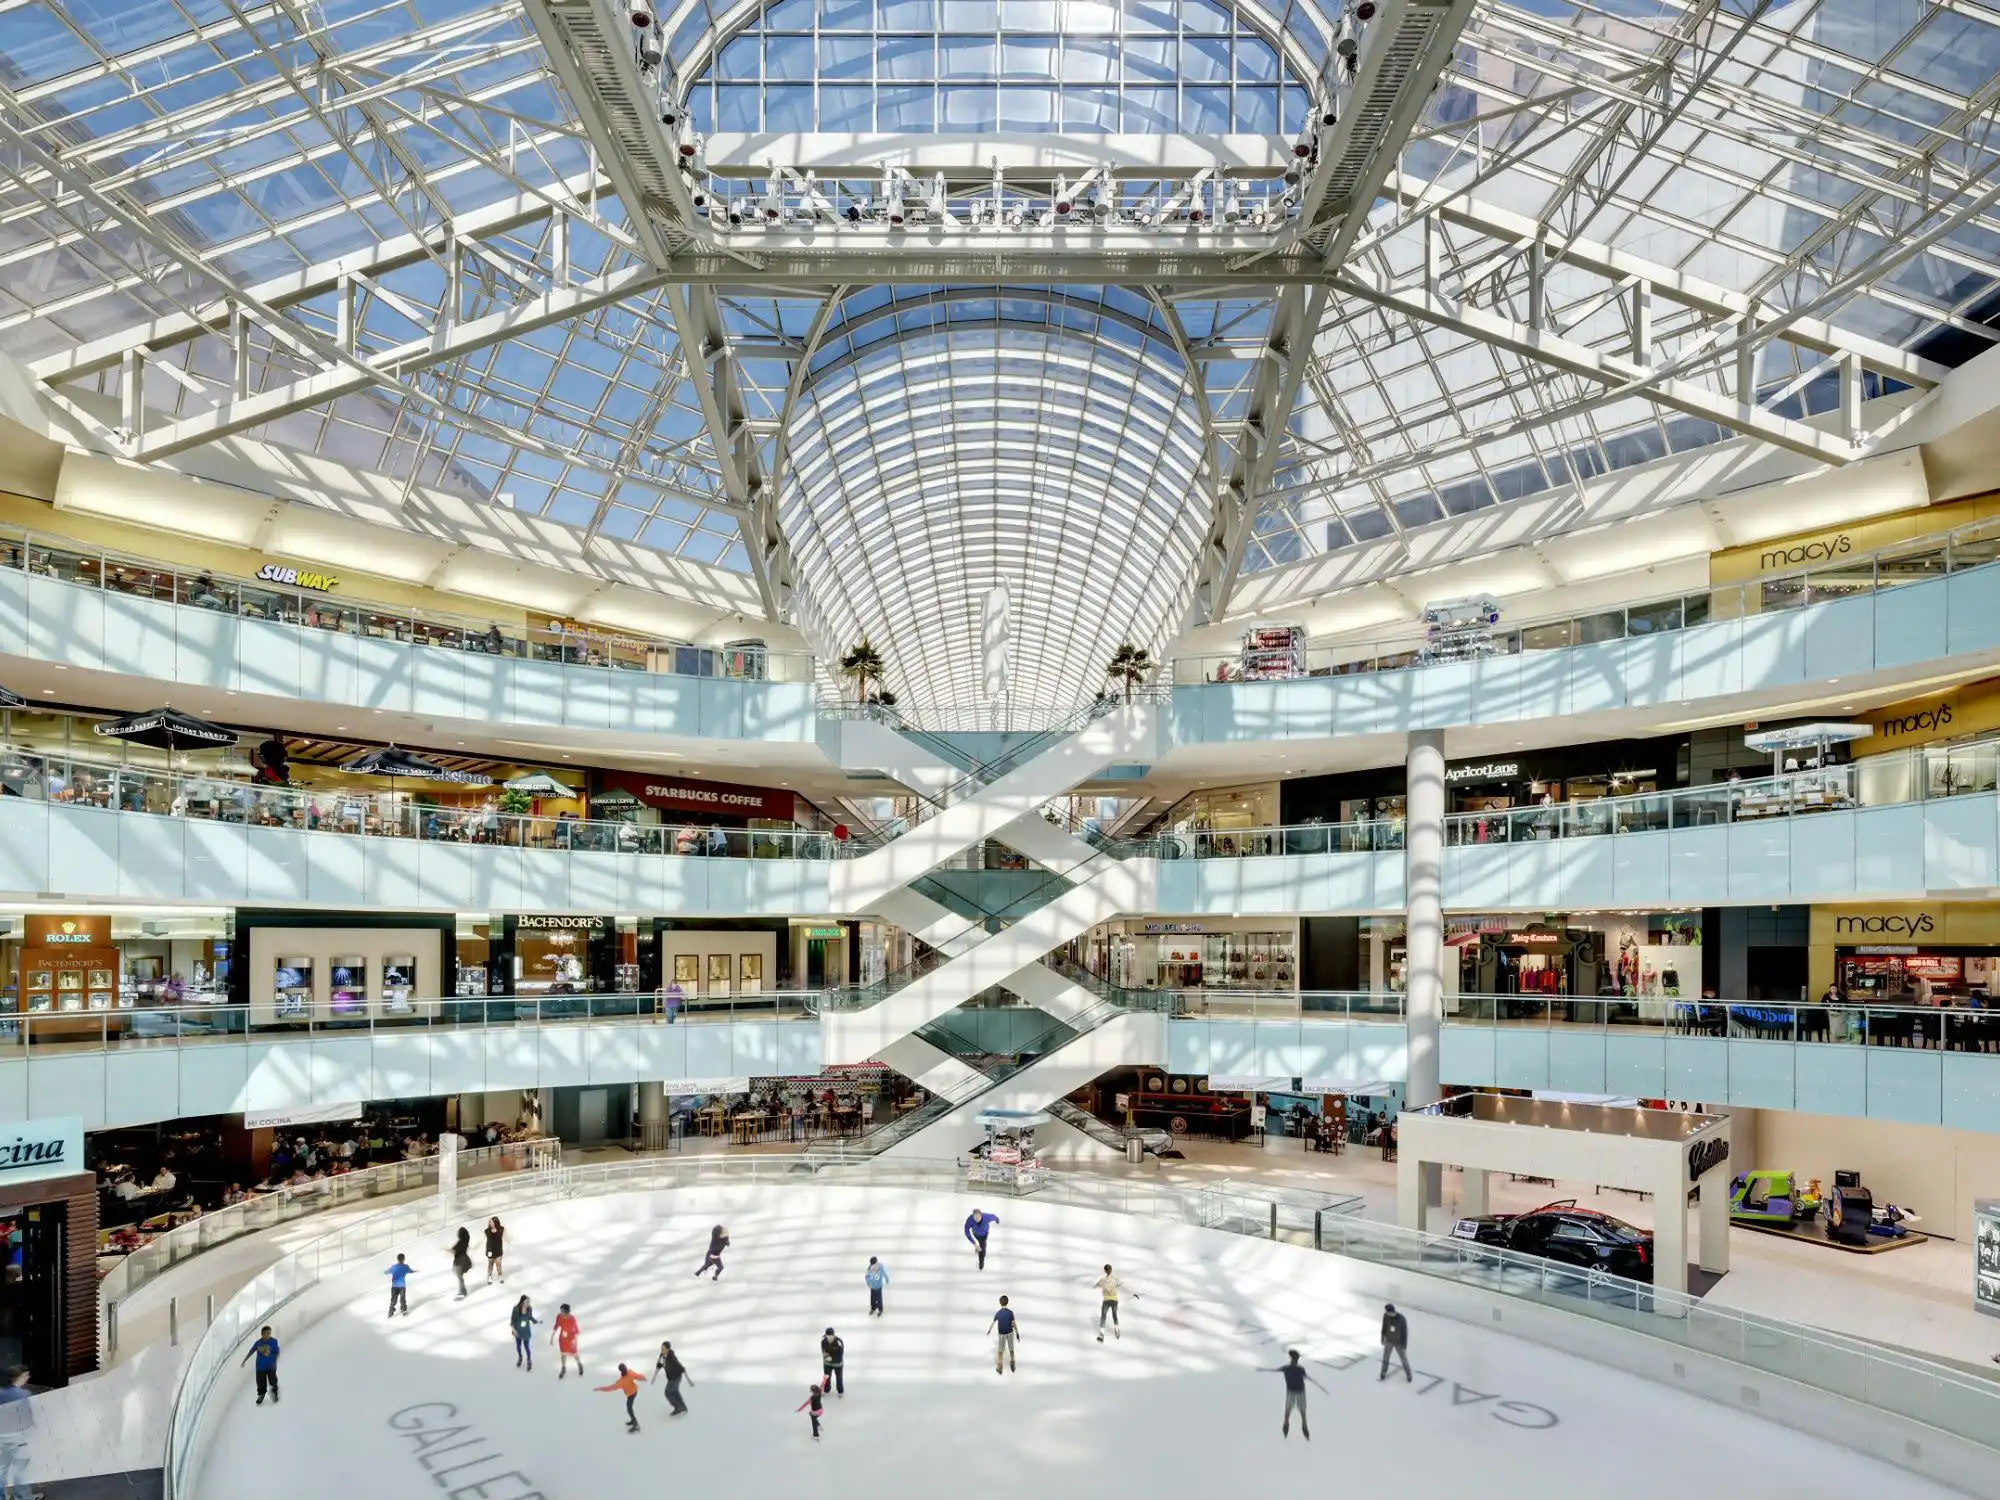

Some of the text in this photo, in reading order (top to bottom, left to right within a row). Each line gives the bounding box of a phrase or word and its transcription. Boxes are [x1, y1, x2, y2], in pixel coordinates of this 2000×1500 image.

[1761, 534, 1851, 569] macy's
[255, 563, 339, 592] SUBWAY
[1884, 704, 1952, 737] macy's
[199, 730, 228, 740] bakery
[645, 785, 762, 807] STARBUCKS COFFEE
[518, 915, 604, 928] BACHENDORF'S
[1837, 913, 1934, 938] macy's
[46, 934, 92, 943] ROLEX
[1511, 934, 1558, 943] Juicy Couture
[259, 1117, 292, 1126] COCINA
[387, 1401, 548, 1500] GALLE
